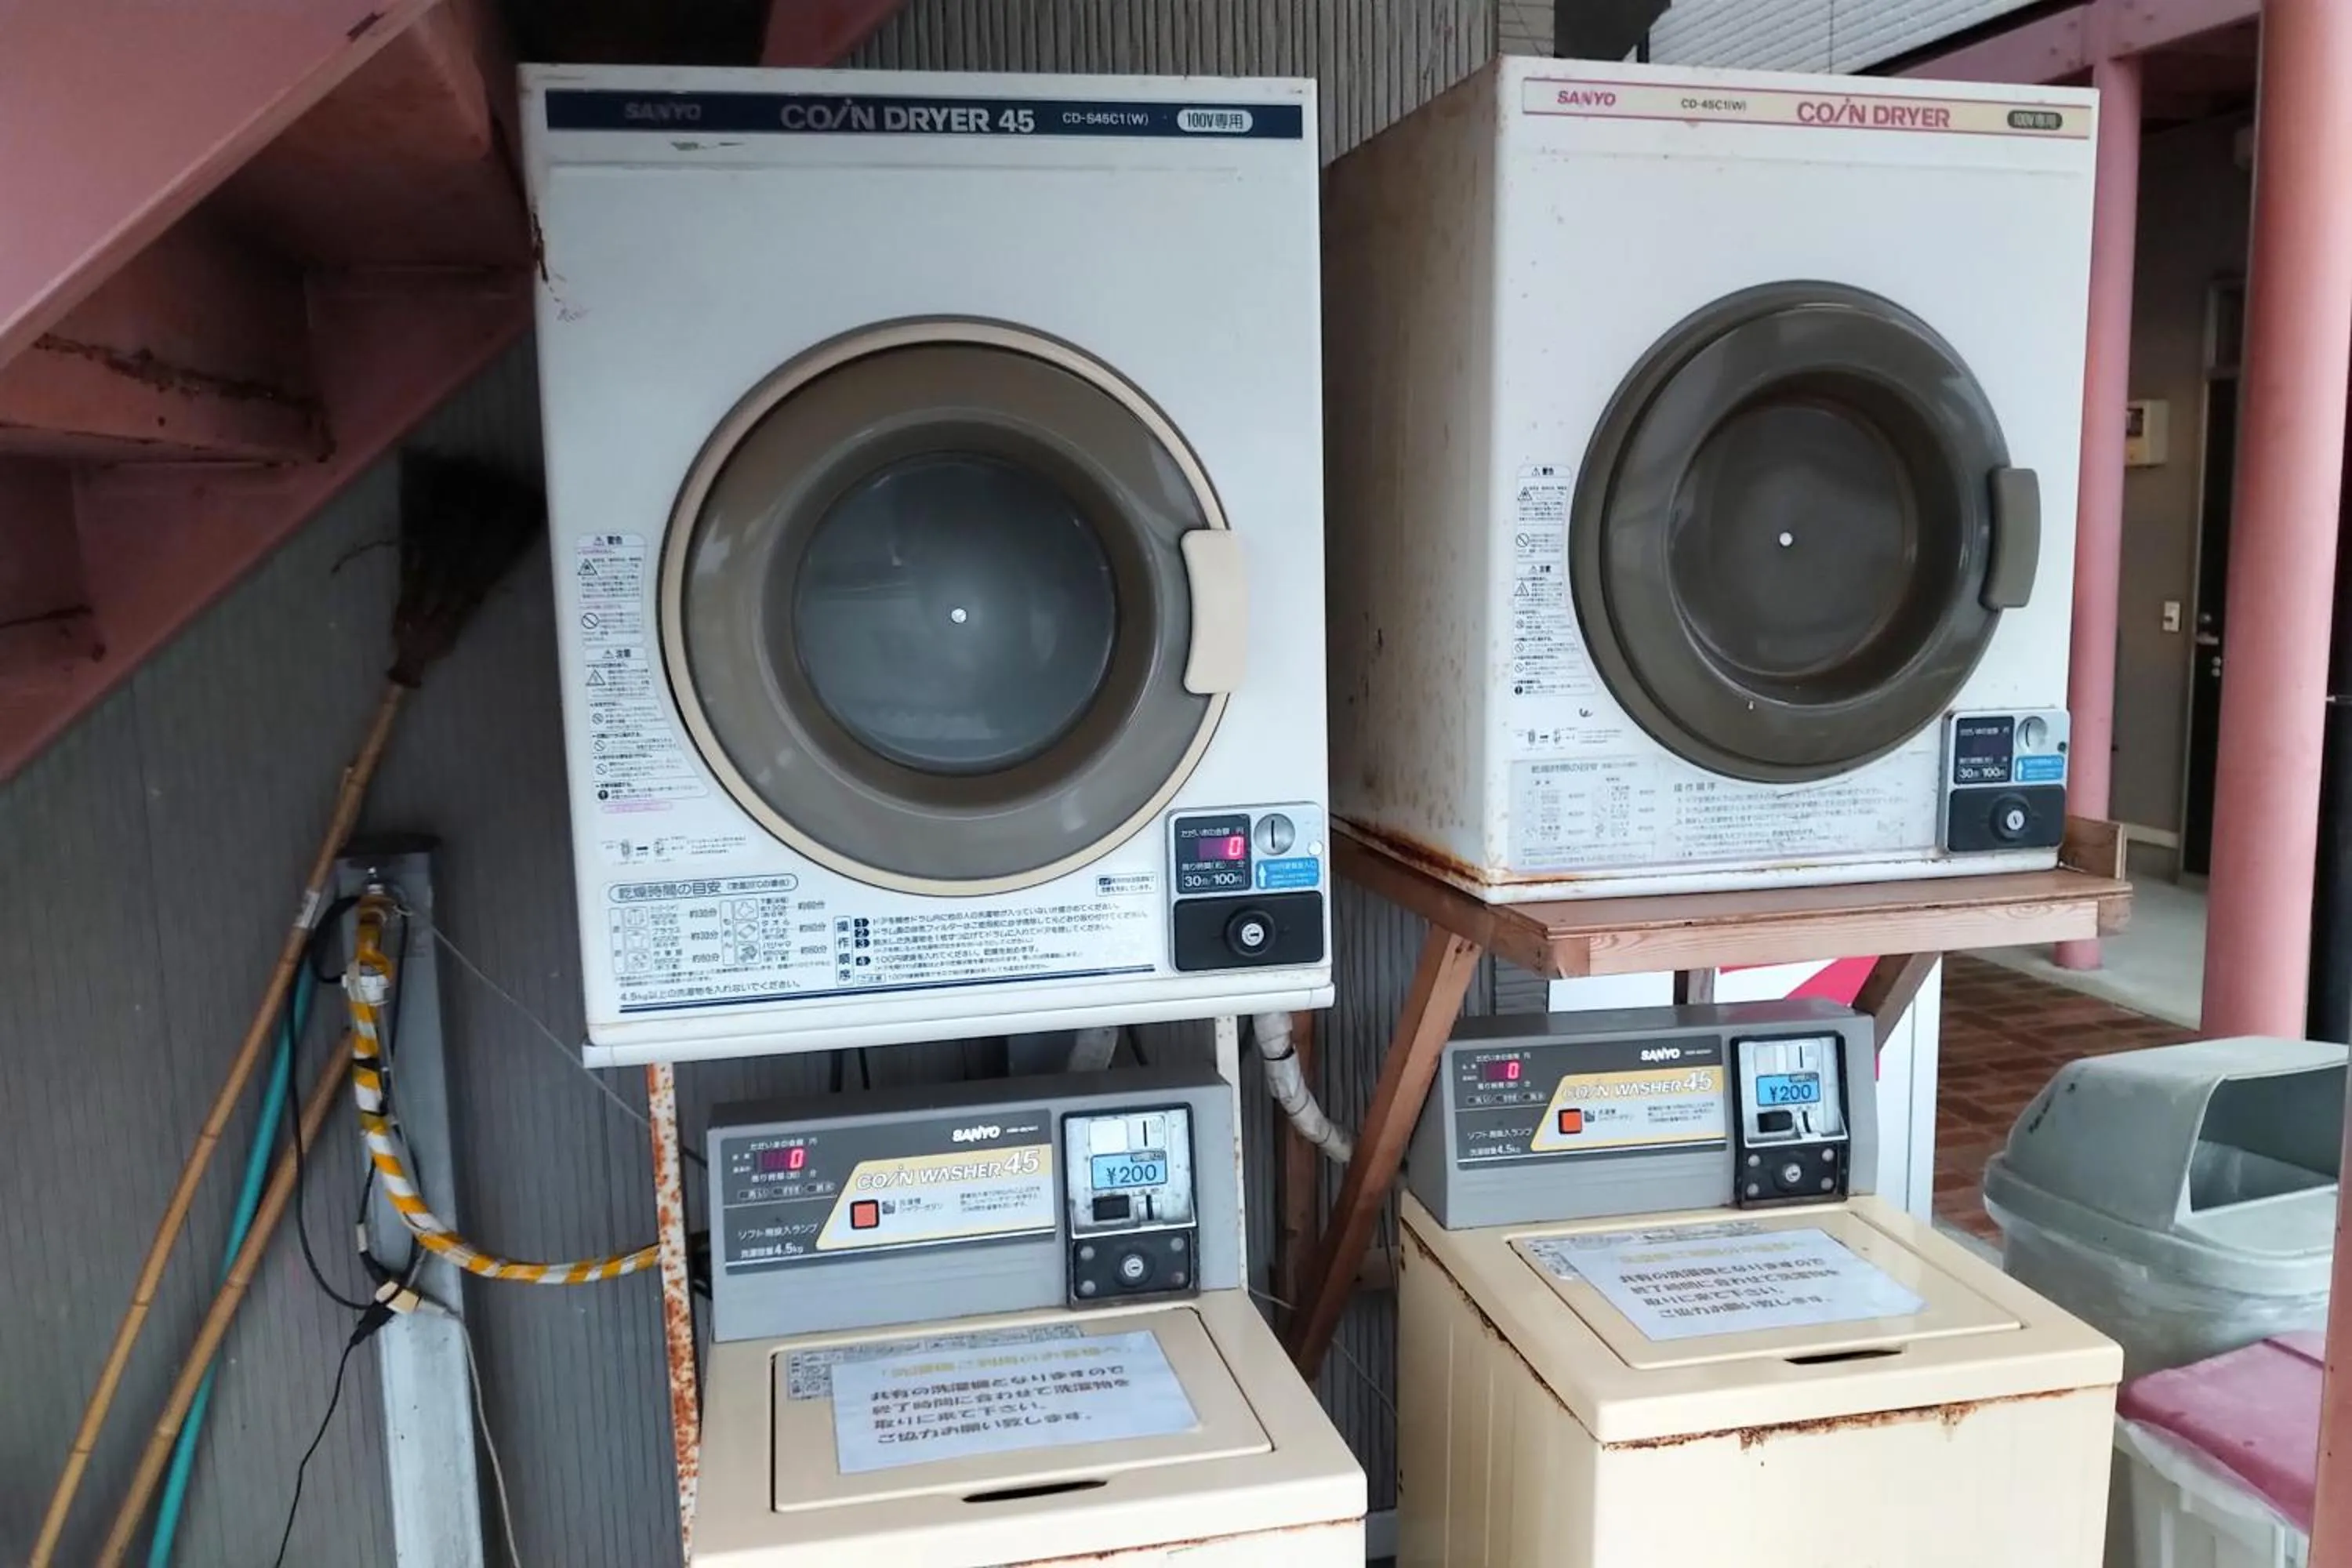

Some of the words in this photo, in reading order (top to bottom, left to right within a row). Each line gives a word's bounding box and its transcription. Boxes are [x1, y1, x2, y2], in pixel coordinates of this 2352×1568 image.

[625, 102, 702, 123] SANYO
[884, 106, 990, 132] DRYER
[999, 109, 1036, 133] 45
[1557, 90, 1617, 107] SANYO
[1873, 106, 1951, 129] DRYER
[1229, 836, 1242, 856] 0
[1640, 1047, 1681, 1062] SANYO
[1508, 1062, 1519, 1080] 0
[1615, 1080, 1681, 1096] WASHER
[1683, 1071, 1713, 1091] 45
[952, 1125, 1001, 1142] SANYO
[789, 1148, 804, 1170] 0
[919, 1162, 1004, 1185] WASHER
[1003, 1149, 1040, 1175] 45
[1105, 1163, 1157, 1185] ¥200
